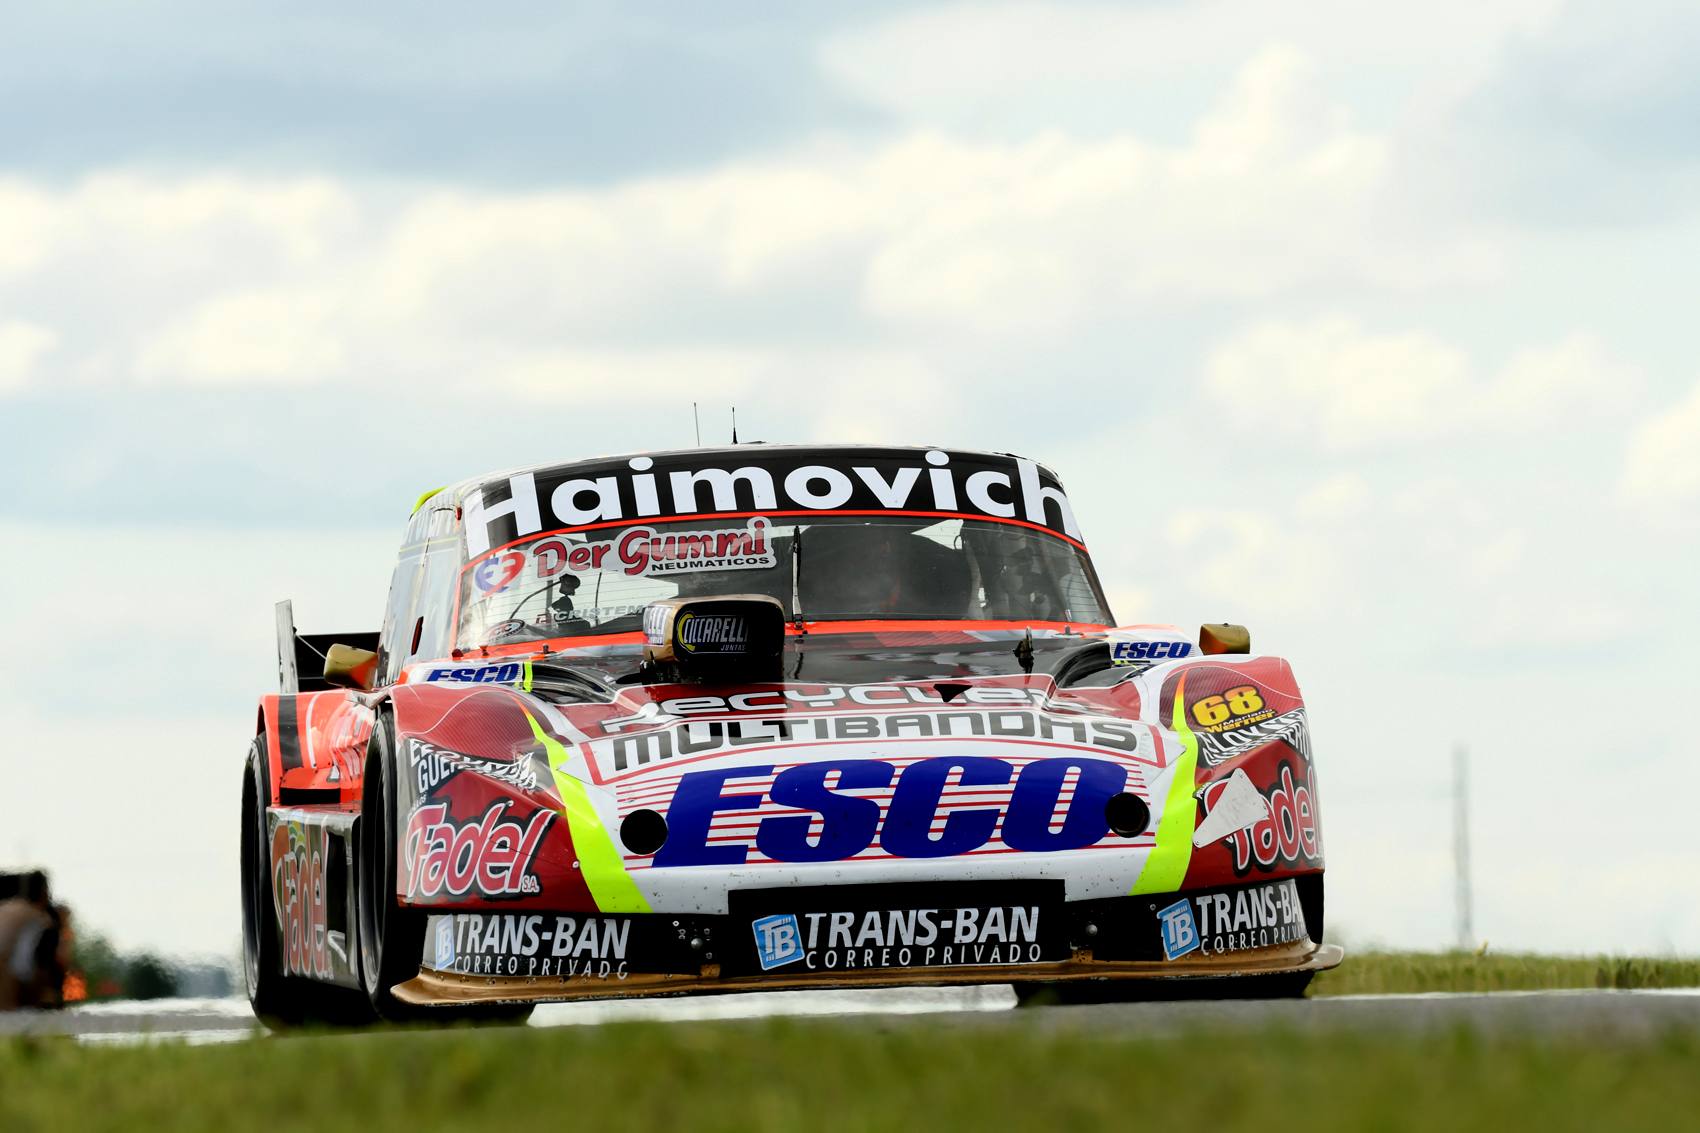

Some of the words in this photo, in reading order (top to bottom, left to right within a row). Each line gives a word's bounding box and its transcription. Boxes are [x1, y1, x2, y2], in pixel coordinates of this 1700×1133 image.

[464, 450, 1082, 560] Haimovich
[533, 540, 611, 578] Der
[618, 520, 768, 576] Gummi
[652, 557, 769, 571] NEUMATICOS
[1114, 641, 1192, 659] ESCO
[427, 663, 519, 682] ESCO
[1192, 685, 1264, 727] 68
[1206, 711, 1276, 733] Werner
[652, 756, 1128, 868] ESCO
[406, 801, 557, 898] Fadel
[522, 875, 540, 893] S.A.
[455, 914, 631, 959] TRANS-BAN
[805, 907, 1039, 948] TRANS-BAN
[1201, 930, 1268, 956] CORREO
[455, 956, 518, 974] CORREO
[806, 948, 911, 969] CORREO
[925, 944, 1041, 965] PRIVADO
